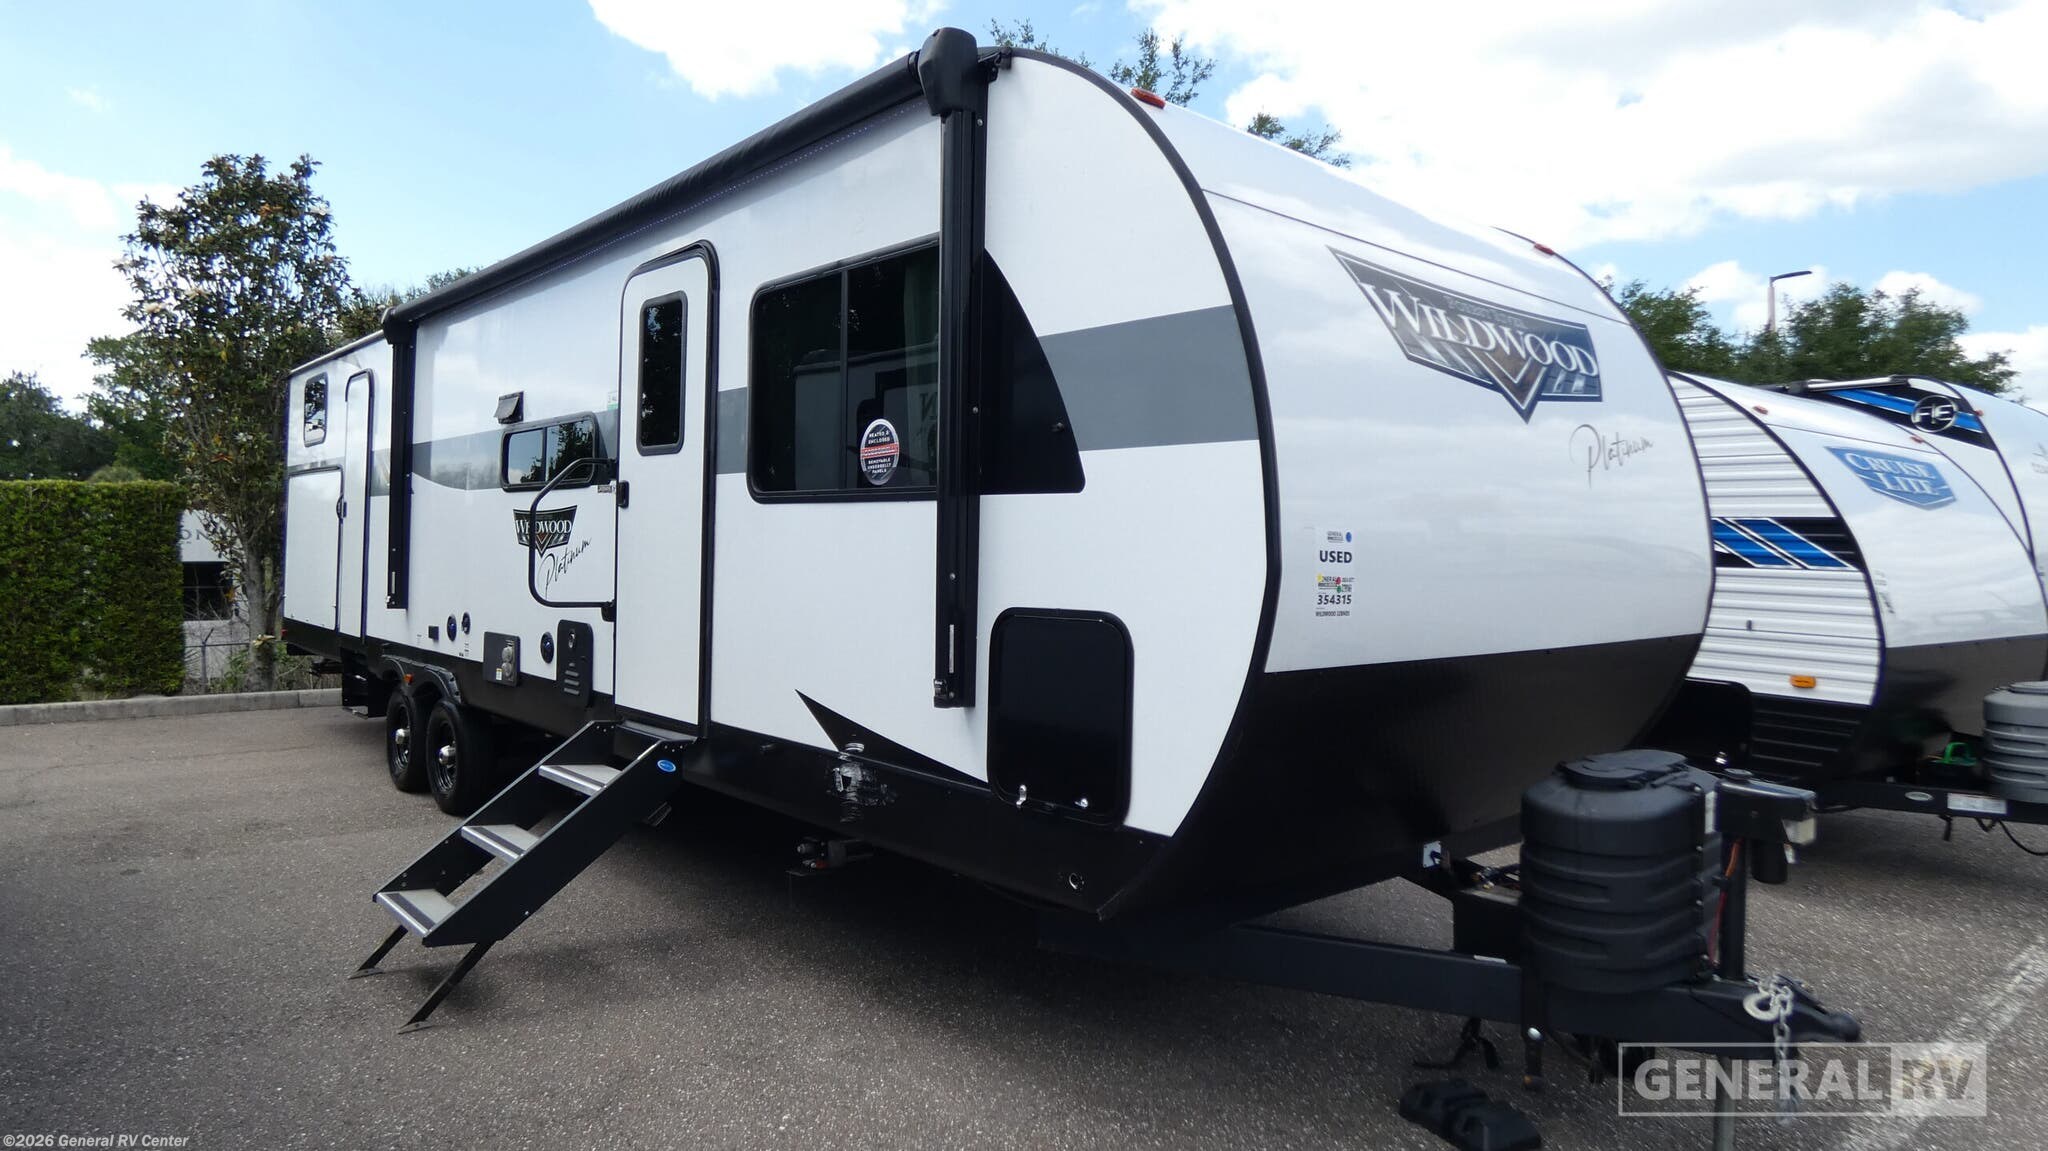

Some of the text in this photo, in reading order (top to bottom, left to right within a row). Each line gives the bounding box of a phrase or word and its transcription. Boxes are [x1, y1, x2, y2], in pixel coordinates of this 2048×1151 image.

[1362, 284, 1599, 377] WILDWOOD
[1569, 424, 1653, 488] Platinum
[1844, 452, 1937, 480] CRUISE
[1873, 473, 1937, 495] LITE
[538, 538, 592, 600] Platinum
[1319, 550, 1353, 564] USED
[1317, 594, 1352, 606] 354315
